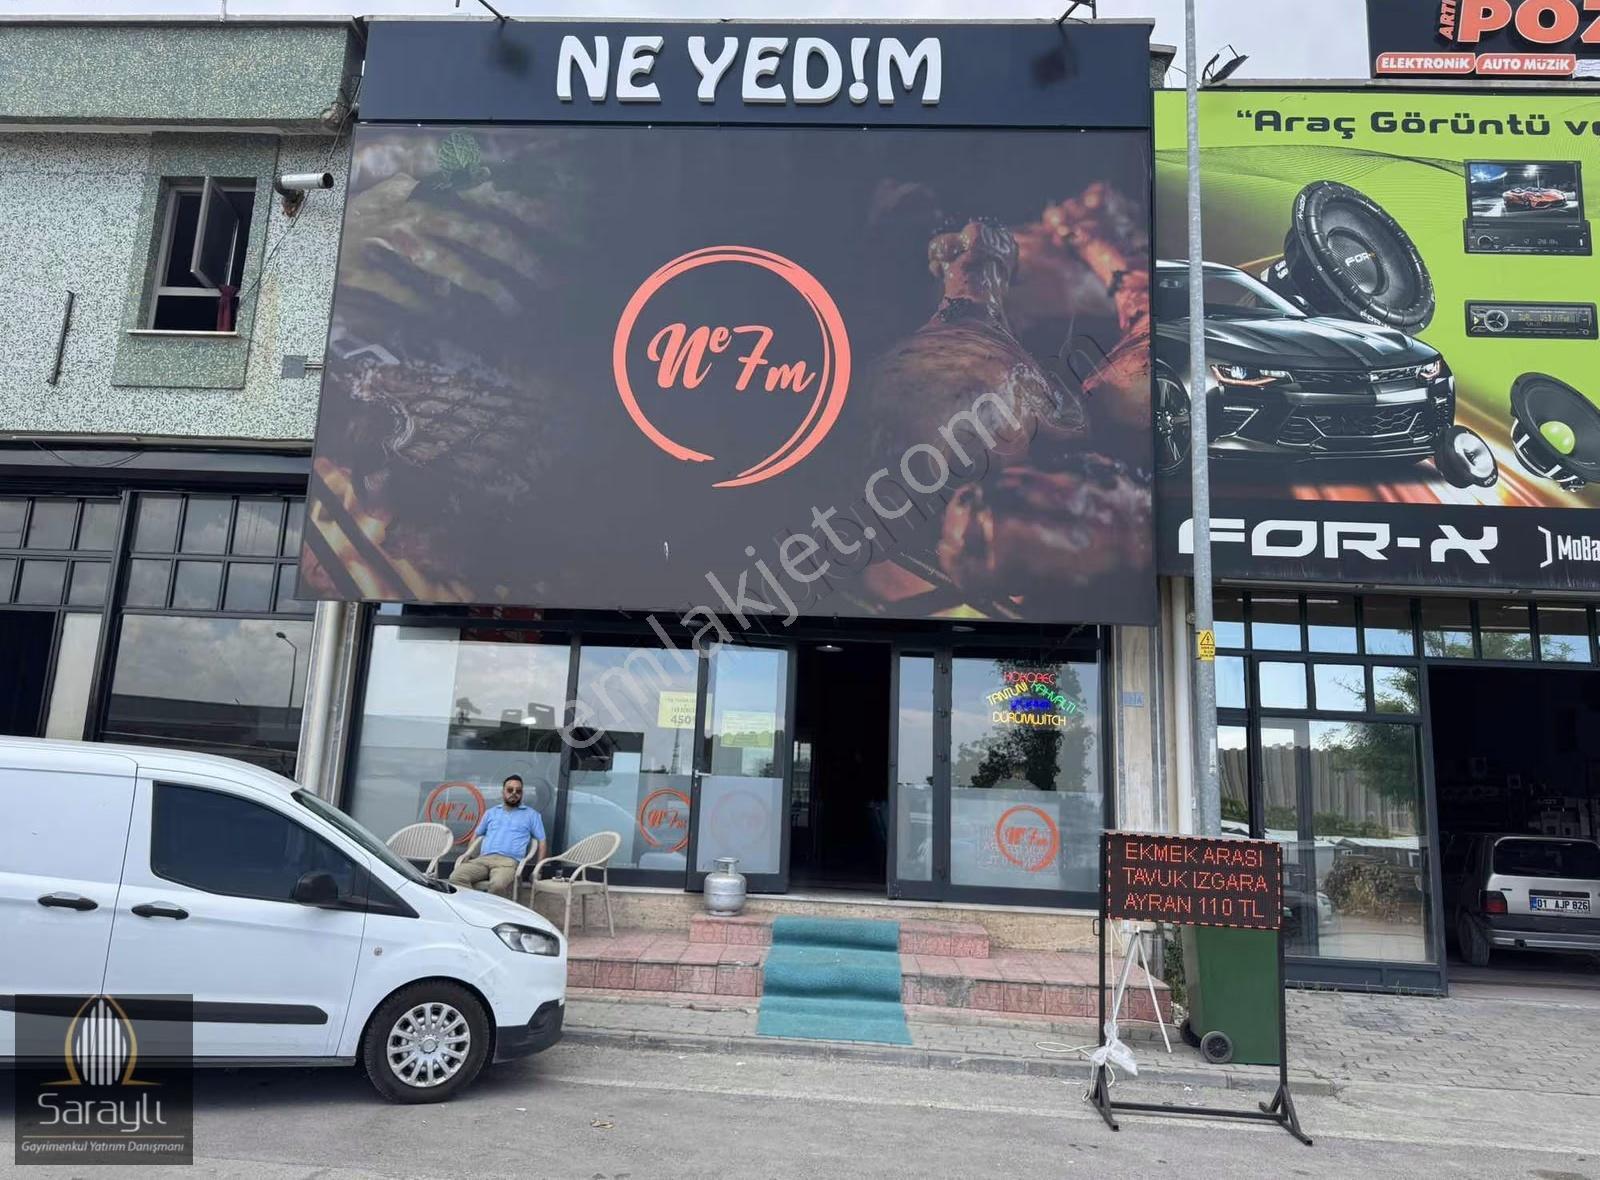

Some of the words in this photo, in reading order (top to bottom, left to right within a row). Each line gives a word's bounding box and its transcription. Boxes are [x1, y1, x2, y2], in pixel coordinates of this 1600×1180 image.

[556, 36, 664, 103] NE
[688, 37, 942, 105] YED!M
[1482, 58, 1521, 70] AUTO
[1370, 111, 1550, 136] Görüntü
[1178, 517, 1499, 565] FOR-X
[1125, 842, 1198, 863] EKMEK
[1202, 847, 1263, 867] ARASI
[1122, 866, 1189, 888] TAVUK
[1193, 871, 1268, 893] IZGARA
[1123, 892, 1192, 914] AYRAN
[1198, 896, 1232, 916] 110
[1238, 898, 1264, 918] TL
[1537, 899, 1547, 908] 01
